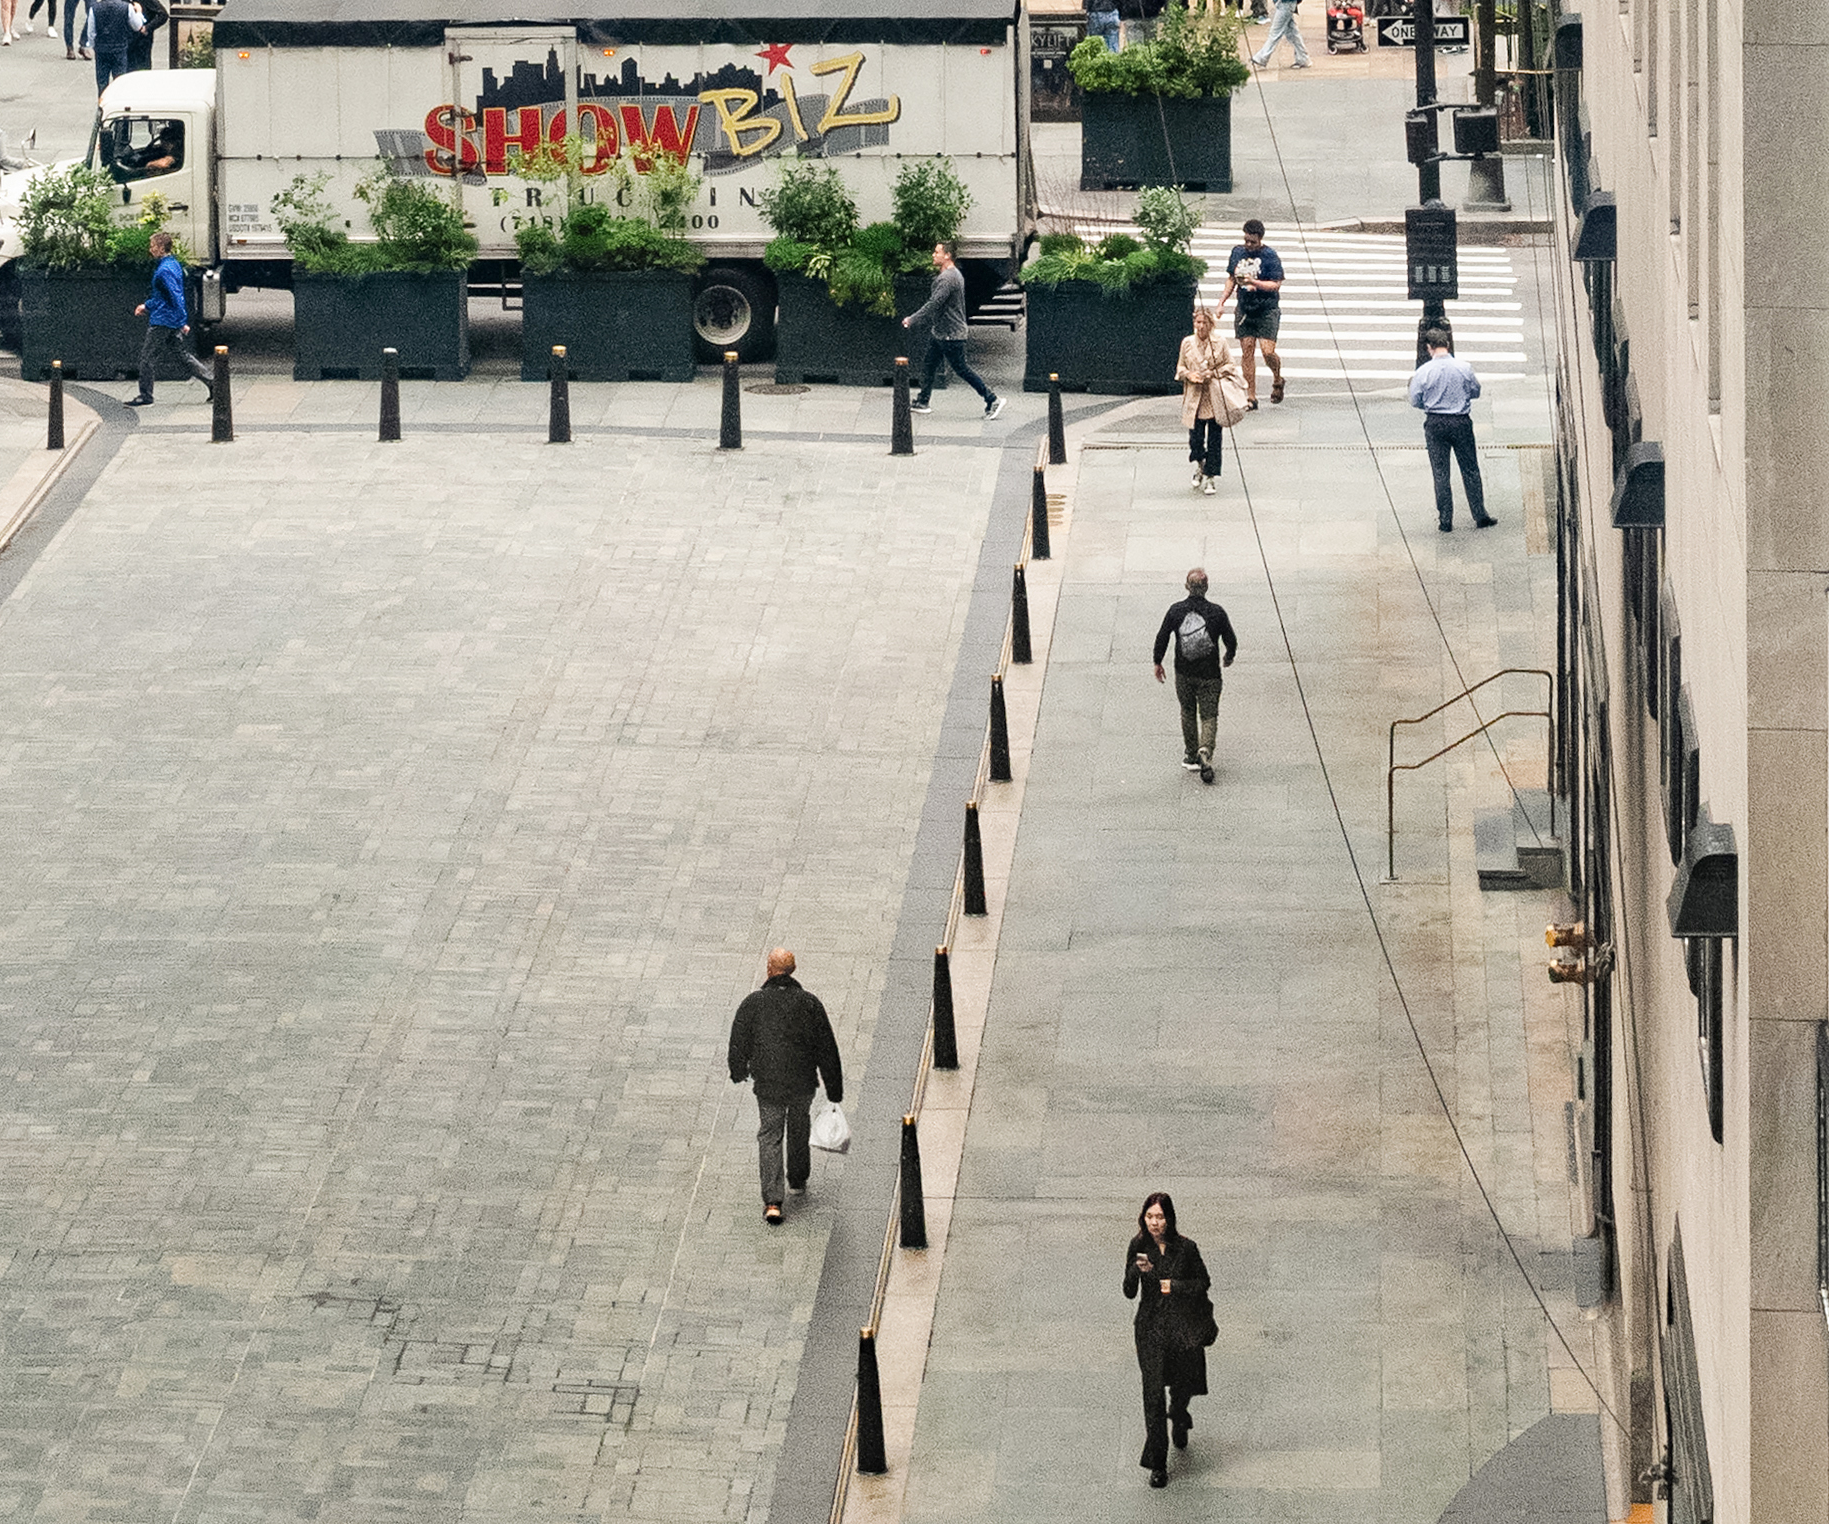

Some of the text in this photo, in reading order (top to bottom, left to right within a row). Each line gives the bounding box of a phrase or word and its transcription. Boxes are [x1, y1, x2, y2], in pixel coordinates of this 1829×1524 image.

[1391, 26, 1415, 38] ONE
[1031, 34, 1073, 47] KYLIFT
[424, 51, 902, 177] SHOW BIZ
